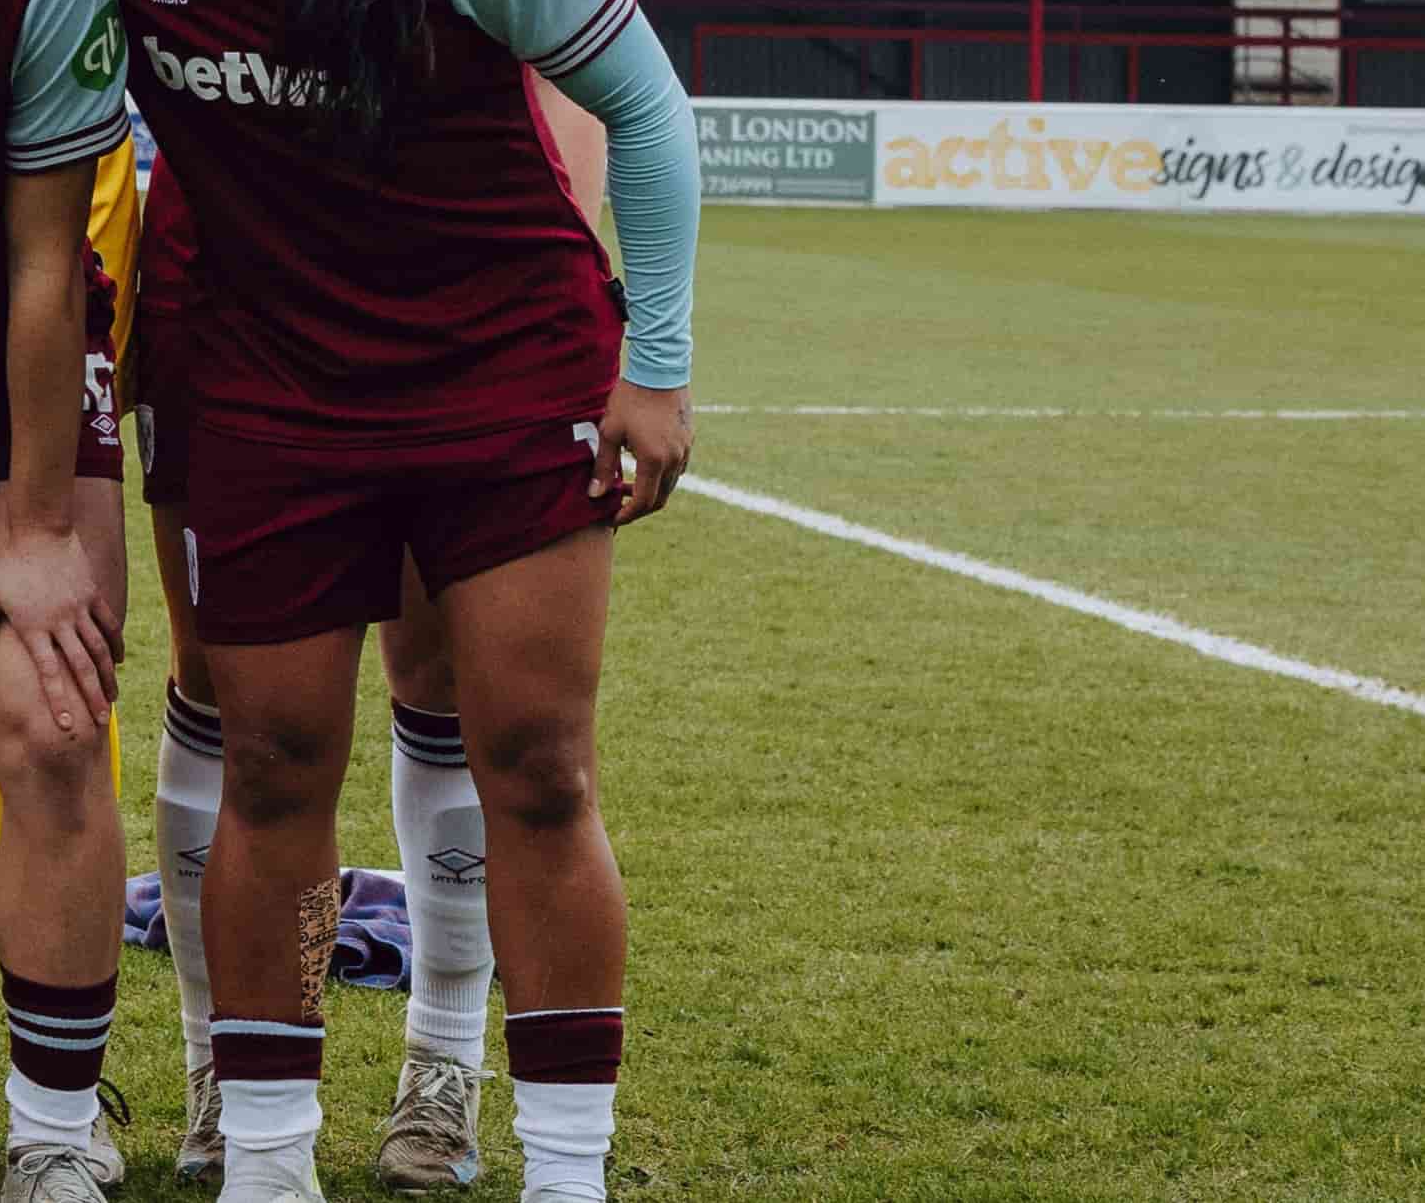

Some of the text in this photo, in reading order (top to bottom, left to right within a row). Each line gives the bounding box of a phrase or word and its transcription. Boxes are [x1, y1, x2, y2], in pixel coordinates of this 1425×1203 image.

[730, 114, 868, 142] LONDON
[884, 118, 1163, 192] active
[1157, 136, 1269, 198] signs
